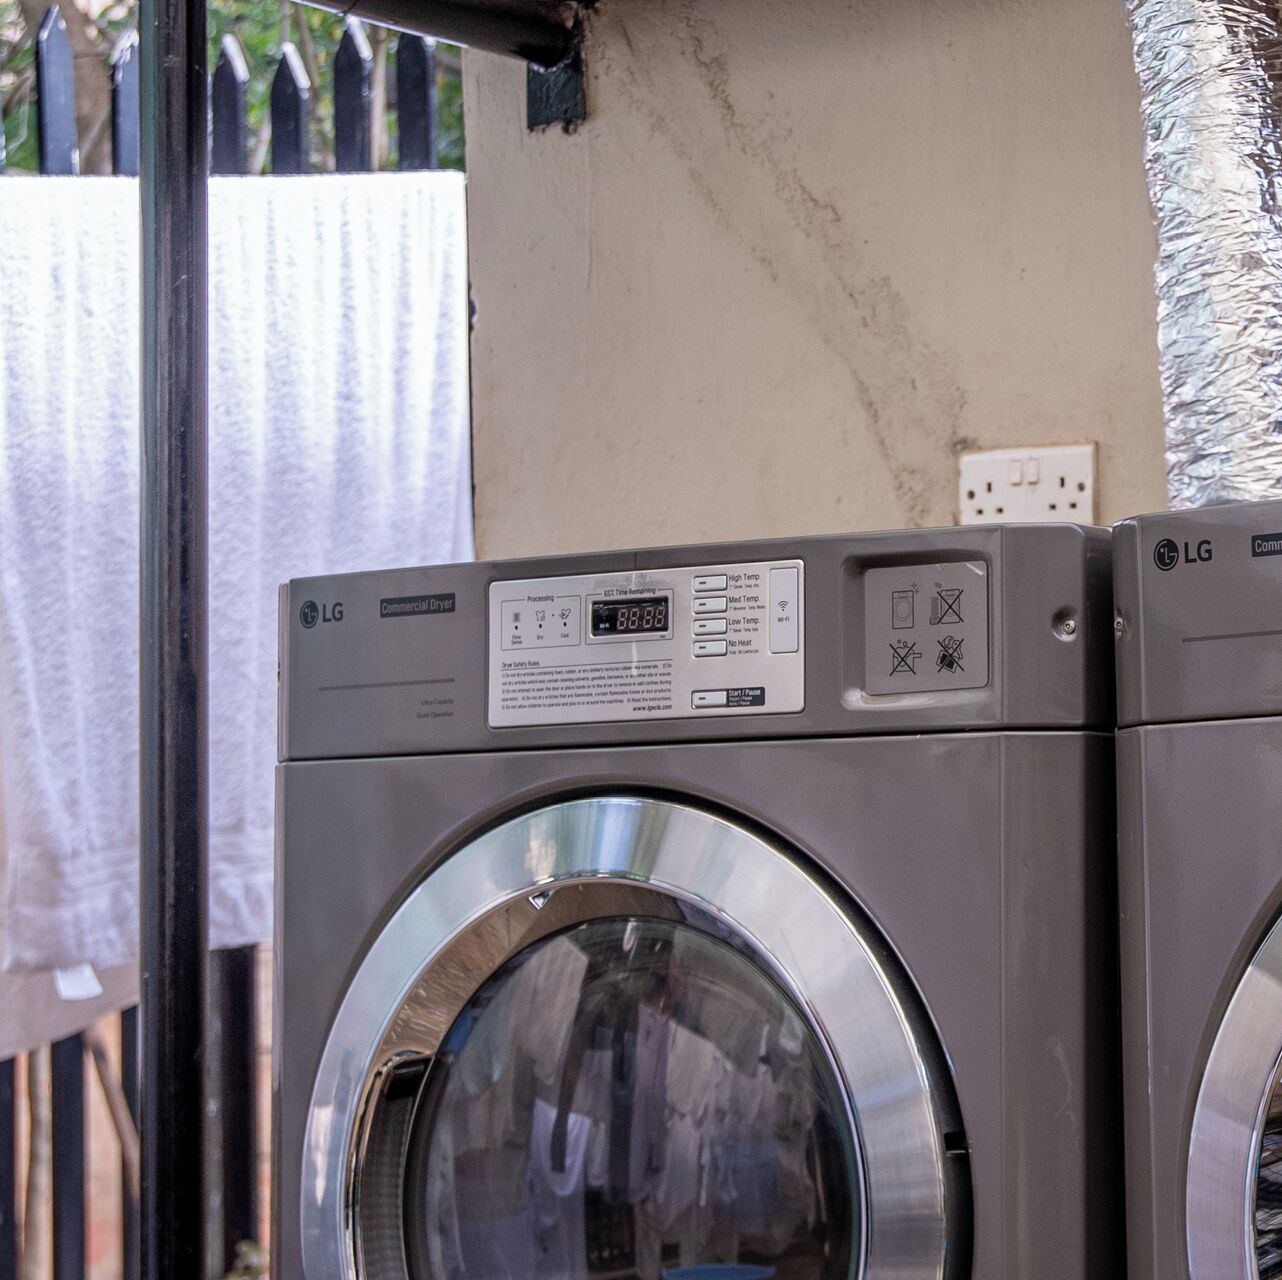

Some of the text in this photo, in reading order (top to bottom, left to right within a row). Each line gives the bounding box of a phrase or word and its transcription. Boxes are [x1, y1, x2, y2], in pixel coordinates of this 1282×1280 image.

[1184, 540, 1213, 563] LG
[729, 574, 742, 583] High
[628, 588, 656, 596] Remaining
[527, 594, 554, 603] Processing
[322, 598, 454, 622] LG Commercial Dryer
[729, 689, 741, 697] Start
[745, 688, 761, 696] Pause
